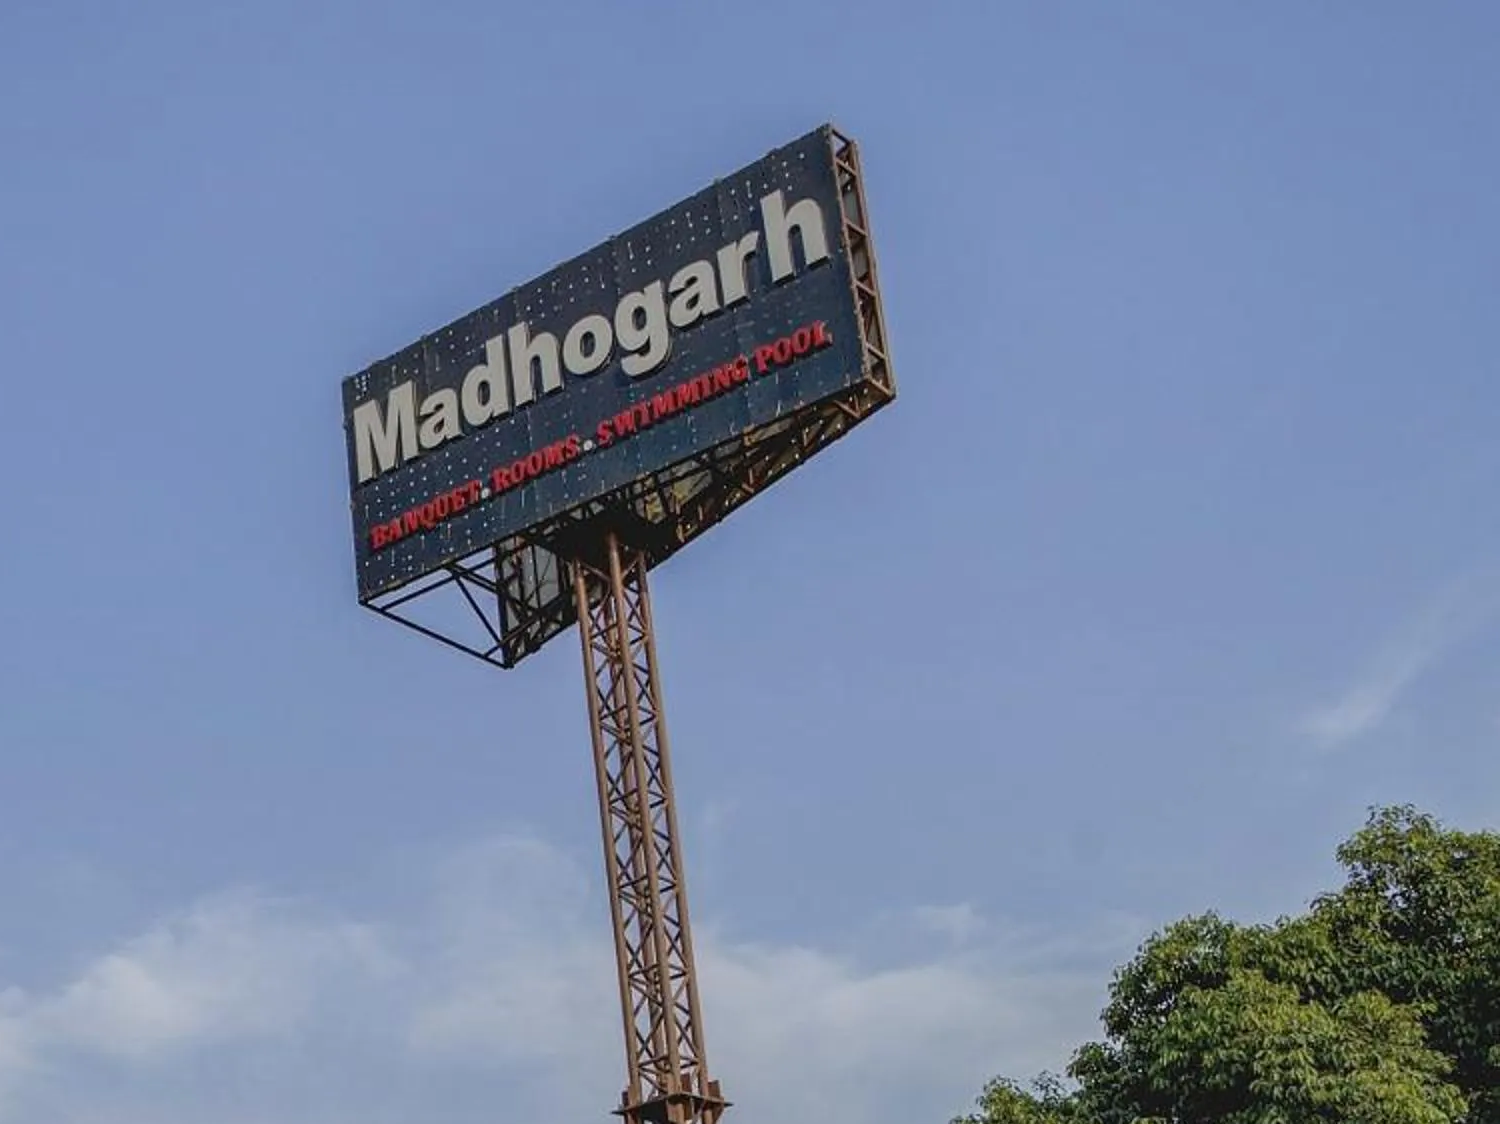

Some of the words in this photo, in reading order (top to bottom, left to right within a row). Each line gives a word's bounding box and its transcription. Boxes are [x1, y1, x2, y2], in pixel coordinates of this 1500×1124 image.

[353, 189, 829, 484] Madhogarh
[370, 479, 483, 550] BANQUET
[489, 433, 582, 492] ROOMS
[596, 353, 750, 447] SWIMMING
[754, 319, 833, 373] POOL
